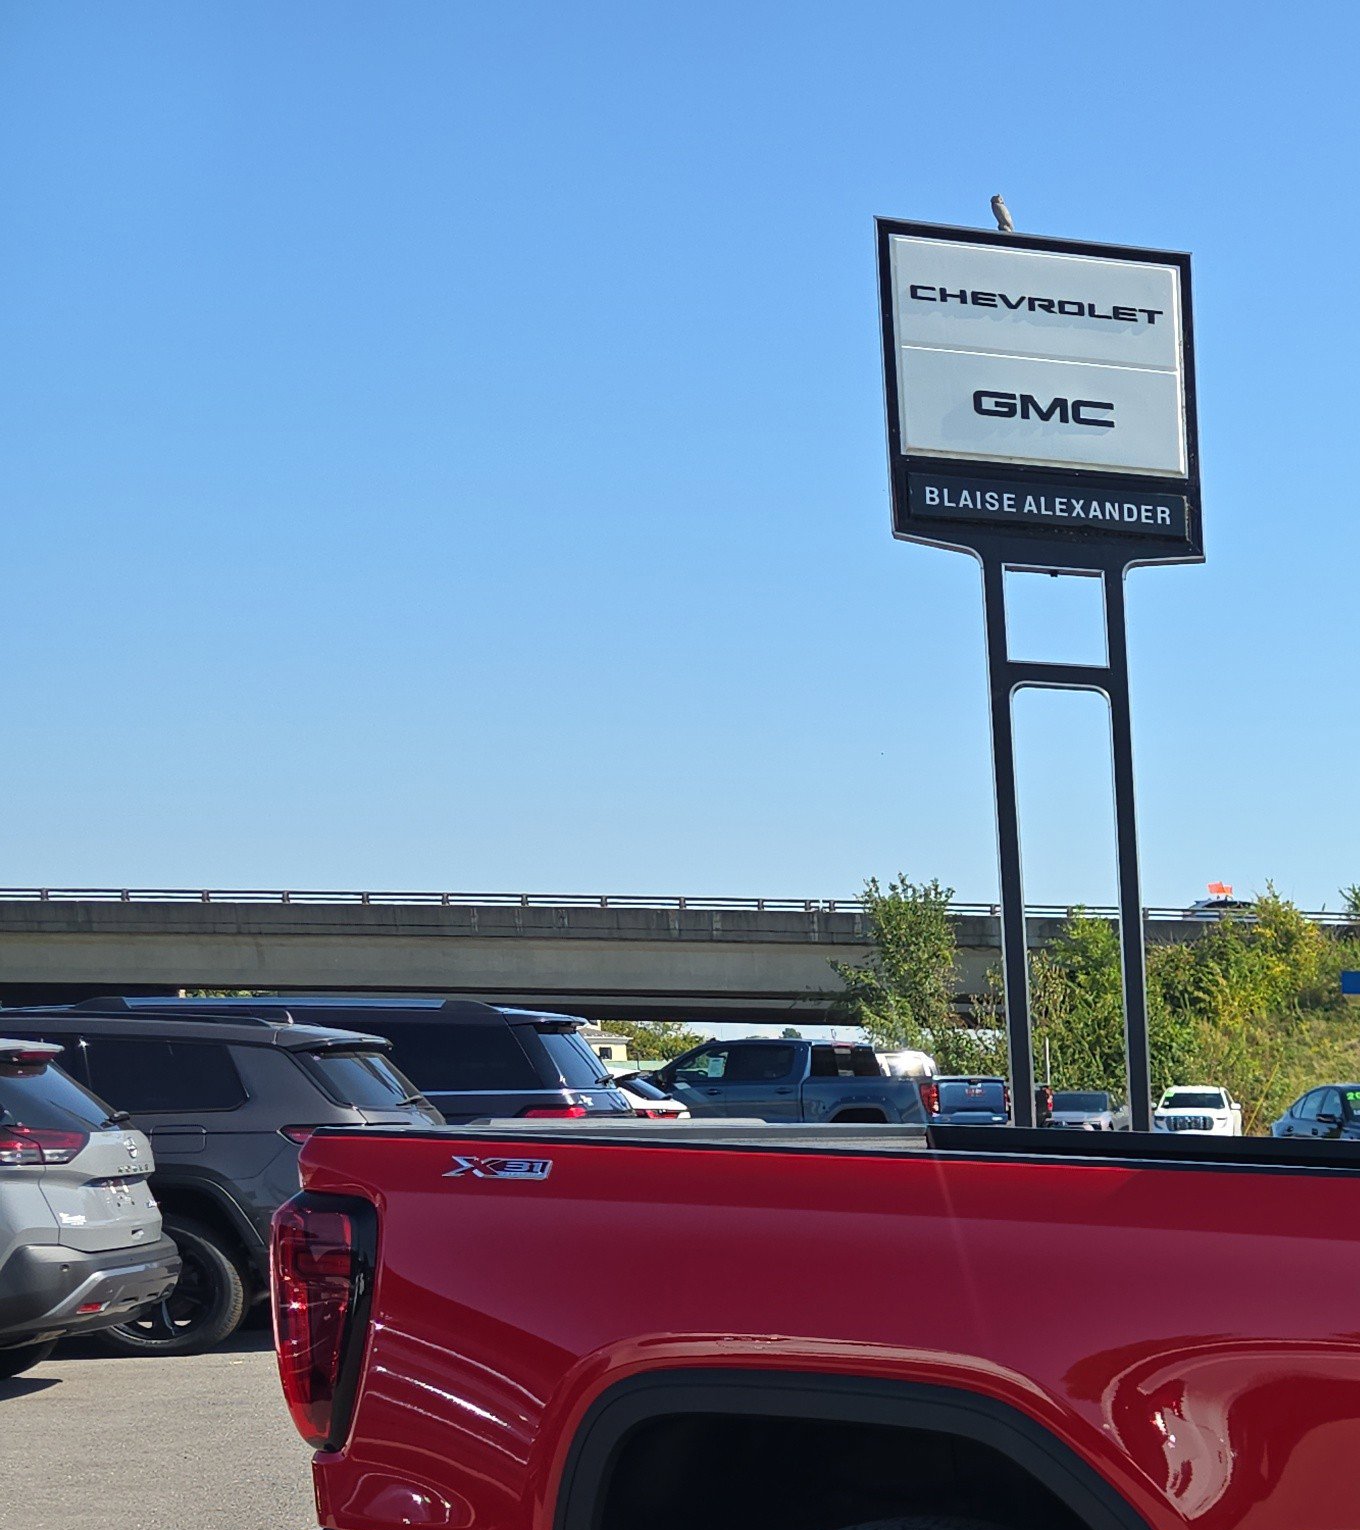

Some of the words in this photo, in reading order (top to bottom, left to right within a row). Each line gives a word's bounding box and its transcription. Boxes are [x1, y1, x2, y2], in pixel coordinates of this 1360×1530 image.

[910, 285, 1163, 324] CHEVROLET
[973, 390, 1115, 428] GMC
[925, 486, 1016, 512] BLAISE
[1023, 495, 1171, 525] ALEXANDER
[442, 1155, 552, 1180] X31
